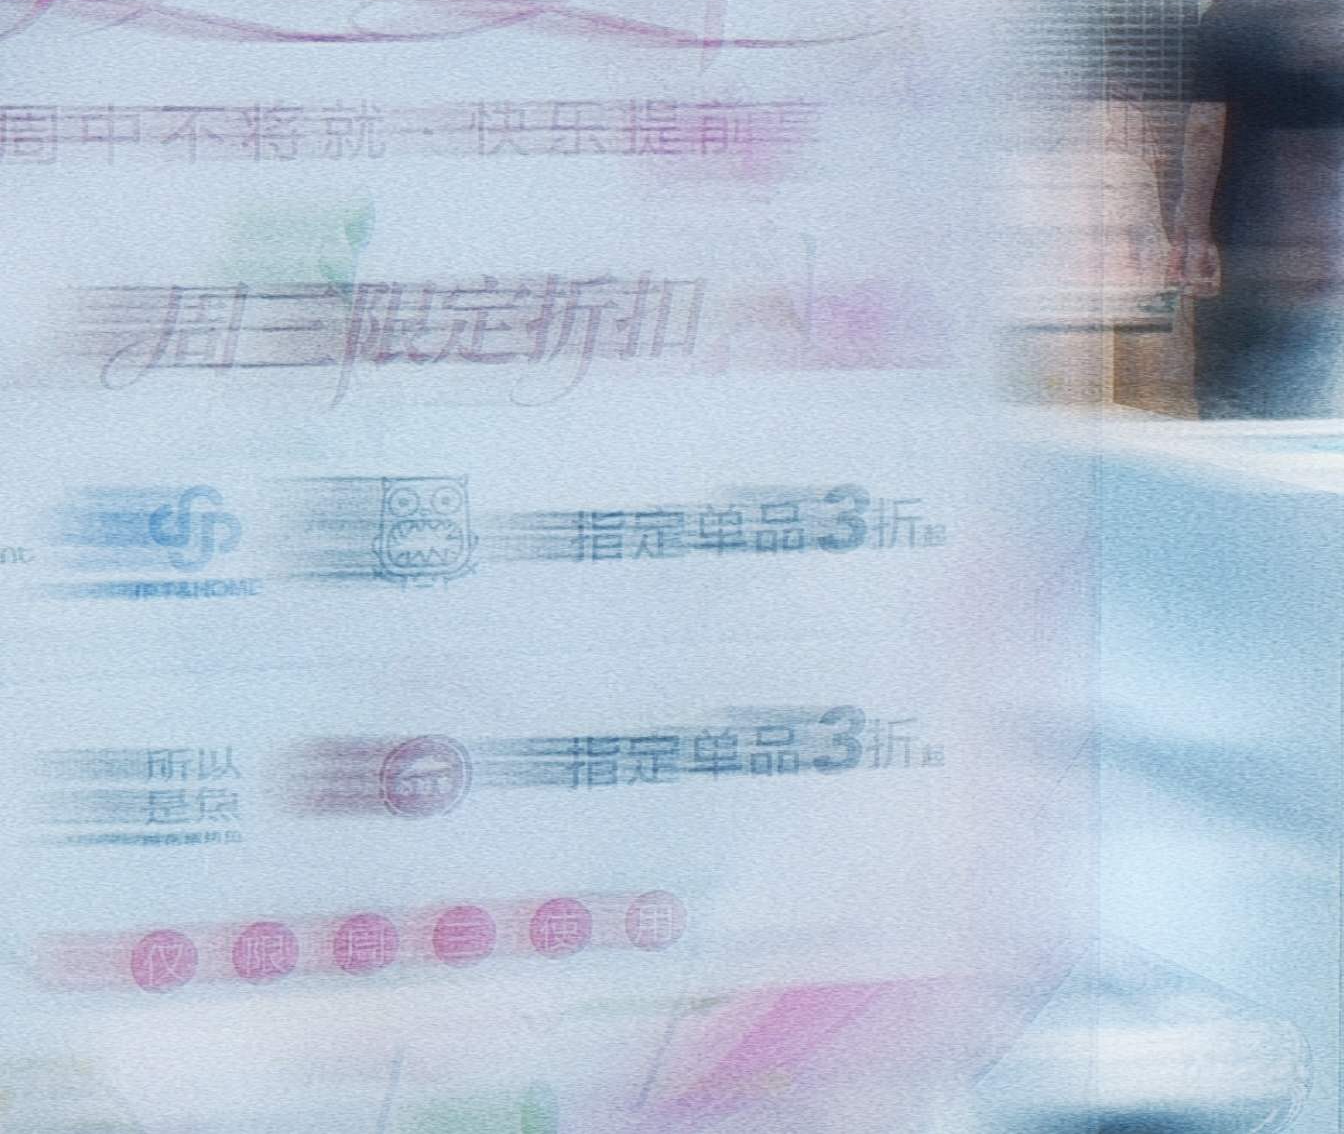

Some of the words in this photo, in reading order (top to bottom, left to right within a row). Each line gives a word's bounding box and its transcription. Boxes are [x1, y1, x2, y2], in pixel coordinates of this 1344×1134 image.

[103, 274, 708, 406] 周三限定折扣
